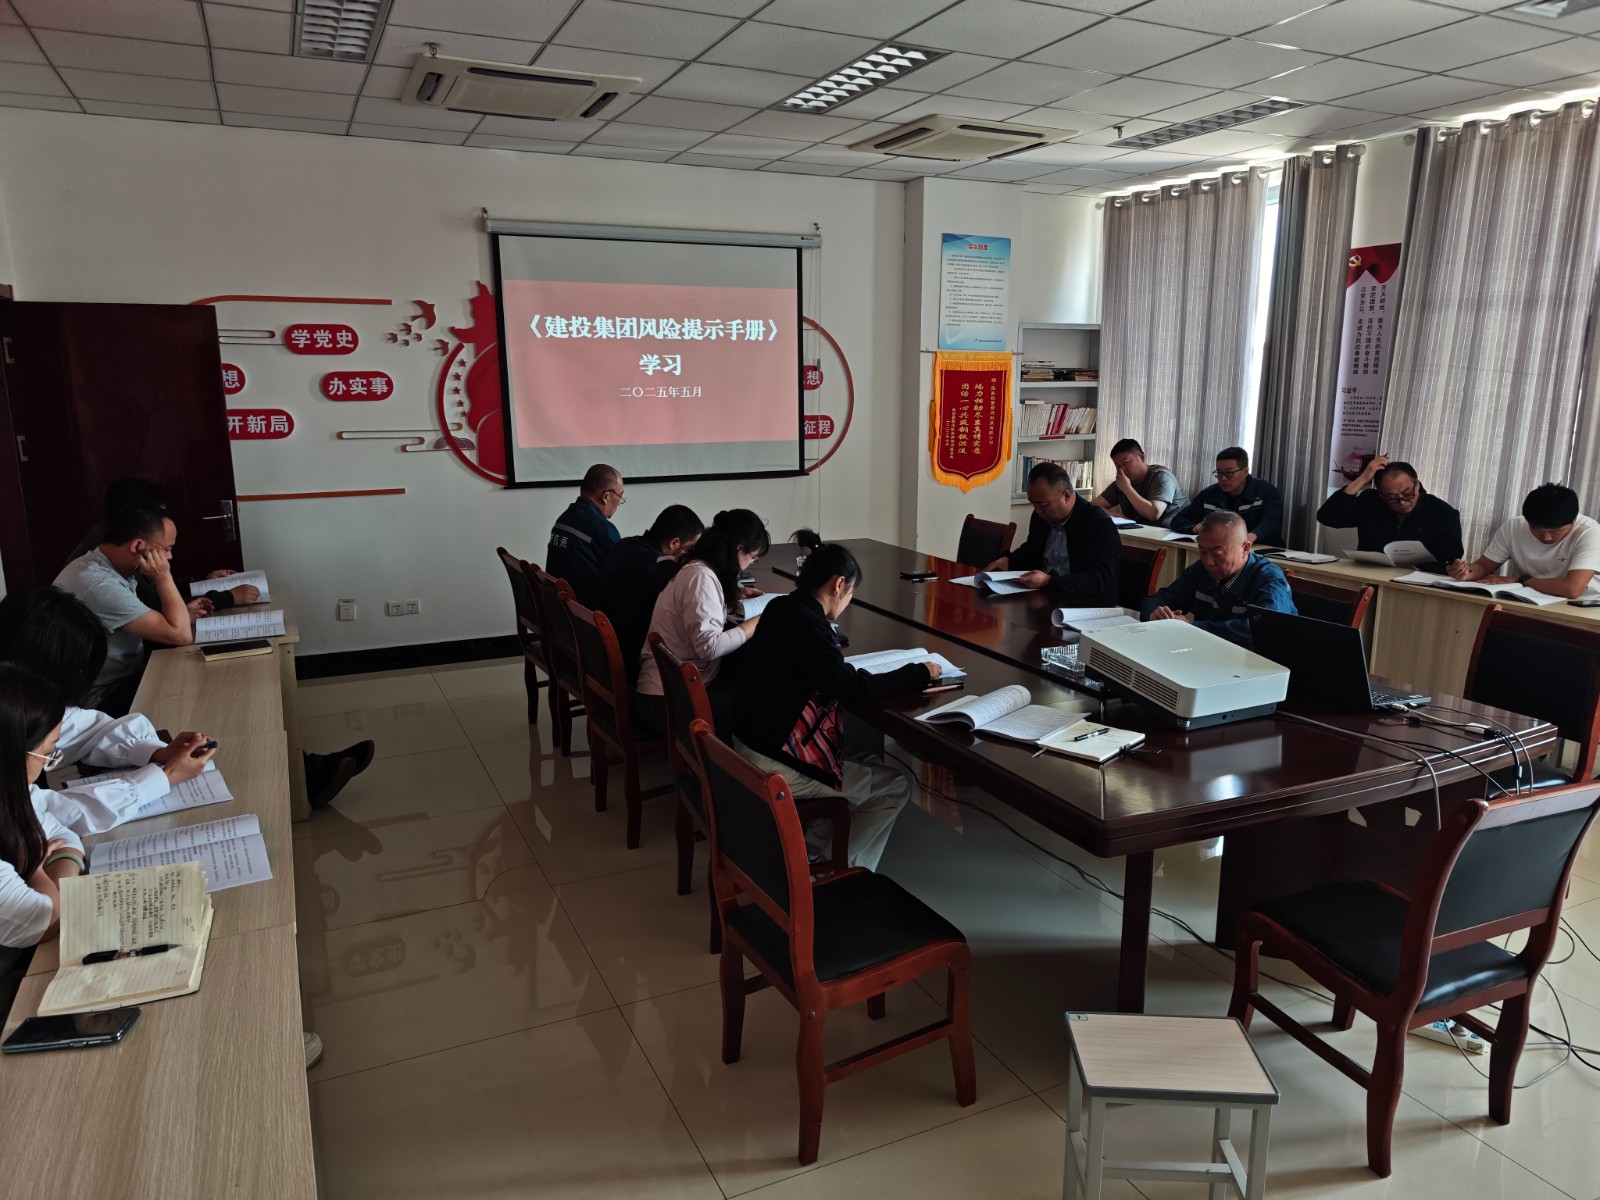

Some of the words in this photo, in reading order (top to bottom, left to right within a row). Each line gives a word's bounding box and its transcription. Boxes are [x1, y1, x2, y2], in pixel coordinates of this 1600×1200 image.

[528, 314, 779, 342] 《建投集团风险提示手册》
[291, 329, 355, 349] 学党史
[638, 353, 682, 376] 学习
[222, 370, 241, 389] 想
[328, 377, 389, 396] 办实事
[803, 370, 821, 385] 想
[619, 385, 703, 399] 二〇二五年五月
[227, 415, 289, 434] 开新局
[804, 420, 832, 435] 征程
